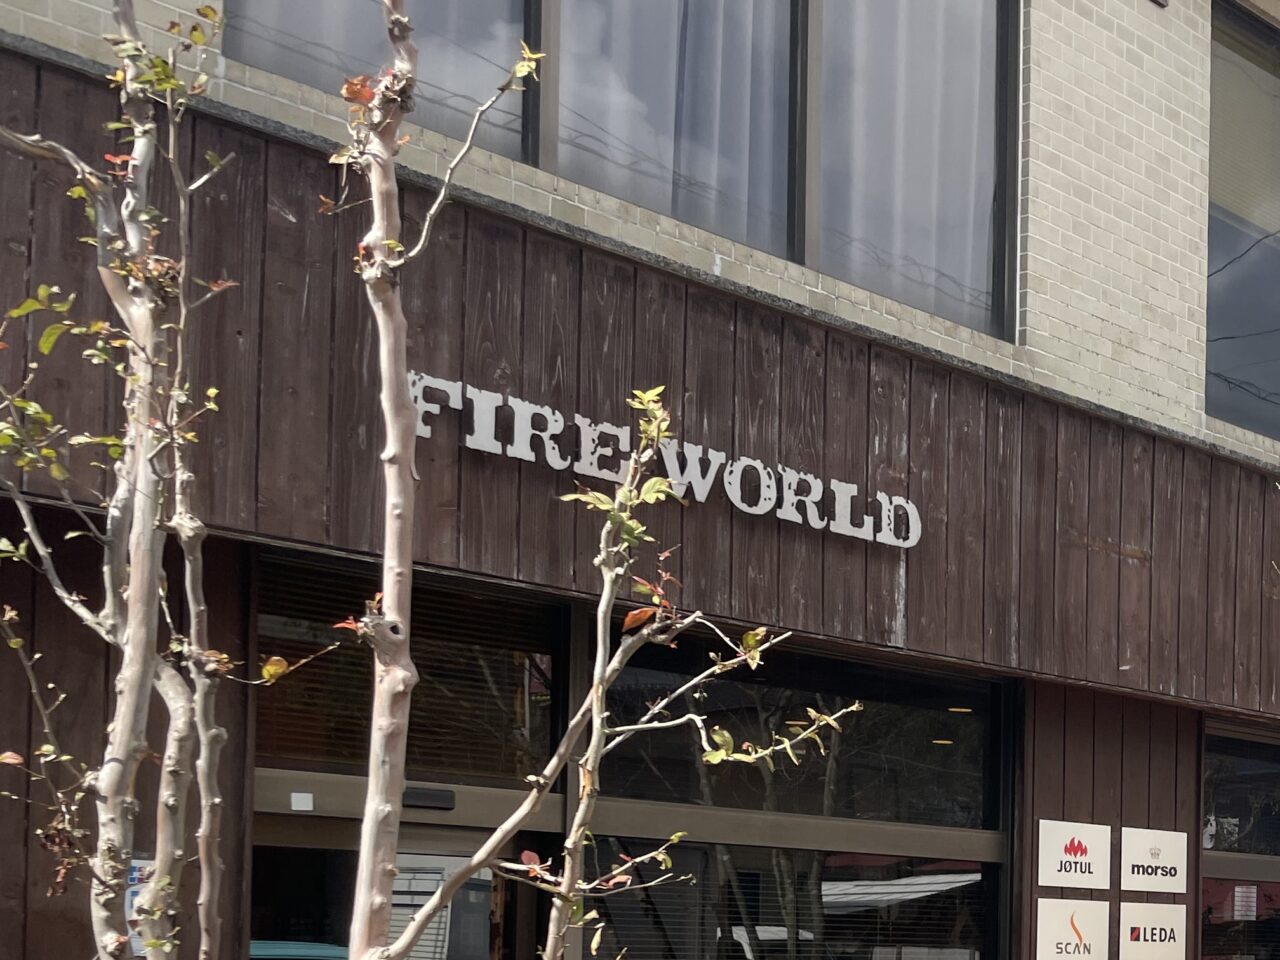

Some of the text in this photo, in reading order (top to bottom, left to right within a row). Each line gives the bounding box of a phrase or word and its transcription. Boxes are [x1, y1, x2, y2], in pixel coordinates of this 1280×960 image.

[407, 370, 922, 549] FIRE WORLD
[1143, 926, 1177, 943] LEDA
[1055, 942, 1091, 955] SCAN
